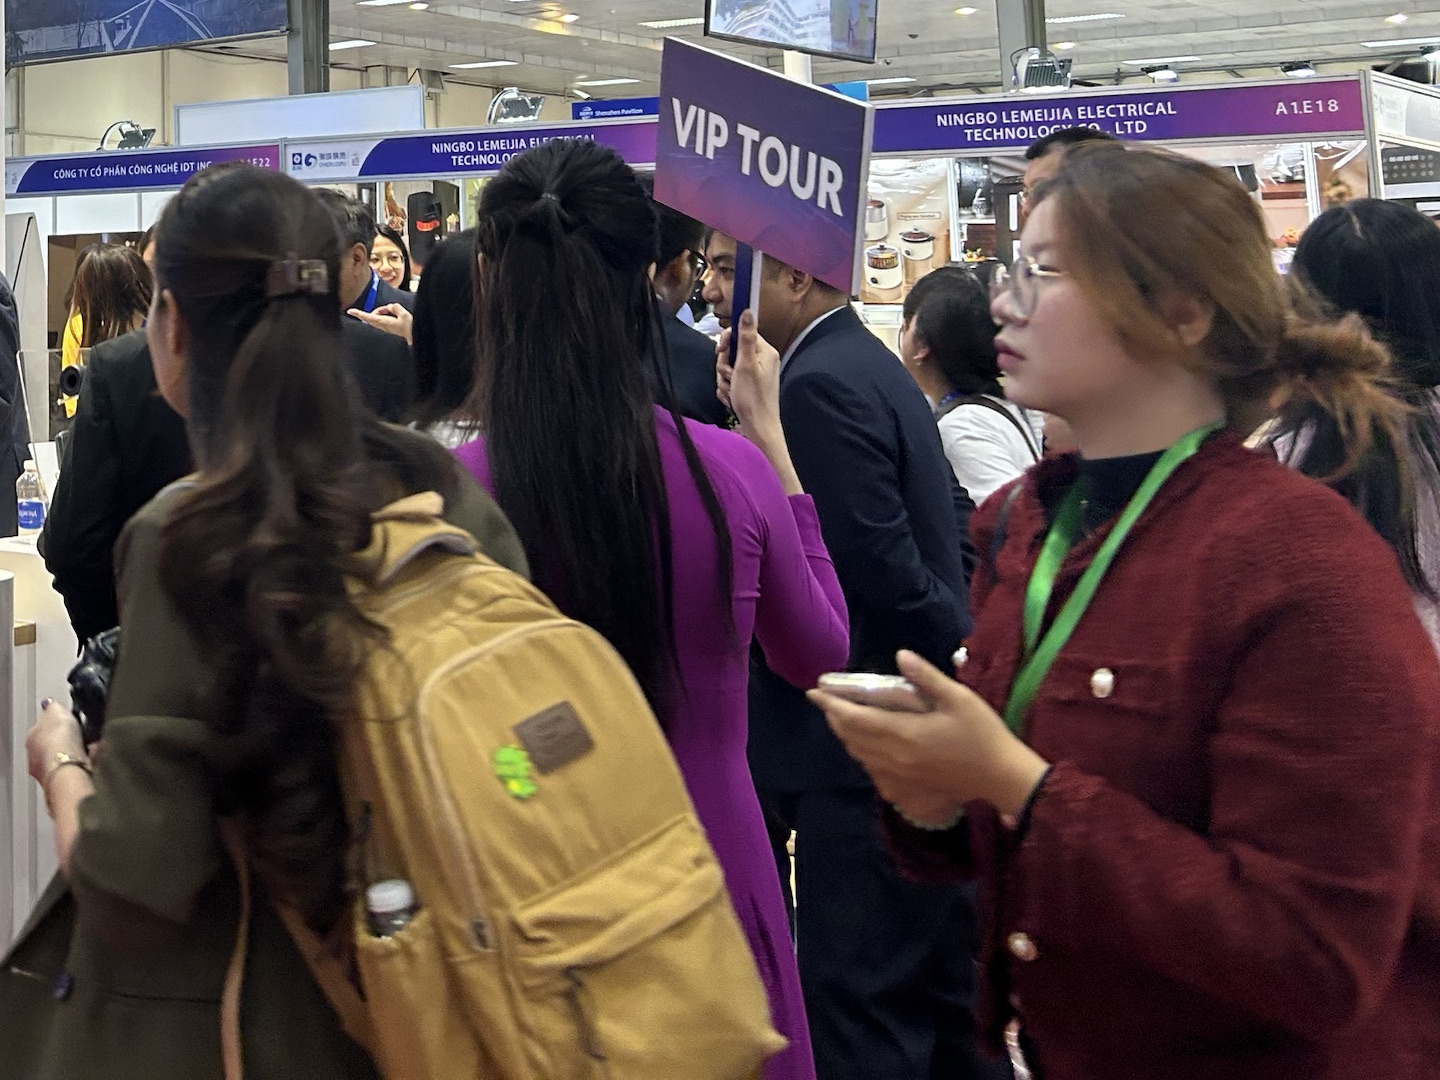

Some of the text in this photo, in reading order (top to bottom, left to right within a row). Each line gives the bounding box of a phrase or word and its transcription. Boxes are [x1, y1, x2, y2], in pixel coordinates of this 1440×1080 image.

[936, 112, 998, 127] NINGBO
[1002, 107, 1073, 124] LEMEIJIA
[1077, 101, 1177, 120] ELECTRICAL
[1115, 120, 1147, 135] LTD
[431, 139, 475, 154] NINGBO
[477, 137, 528, 152] LEMEIJIA
[671, 97, 844, 217] VIP TOUR
[53, 167, 77, 180] CÔNG
[78, 168, 89, 178] TY
[128, 162, 153, 176] CÔNG
[154, 161, 179, 175] NGHỆ
[180, 161, 195, 172] IDT
